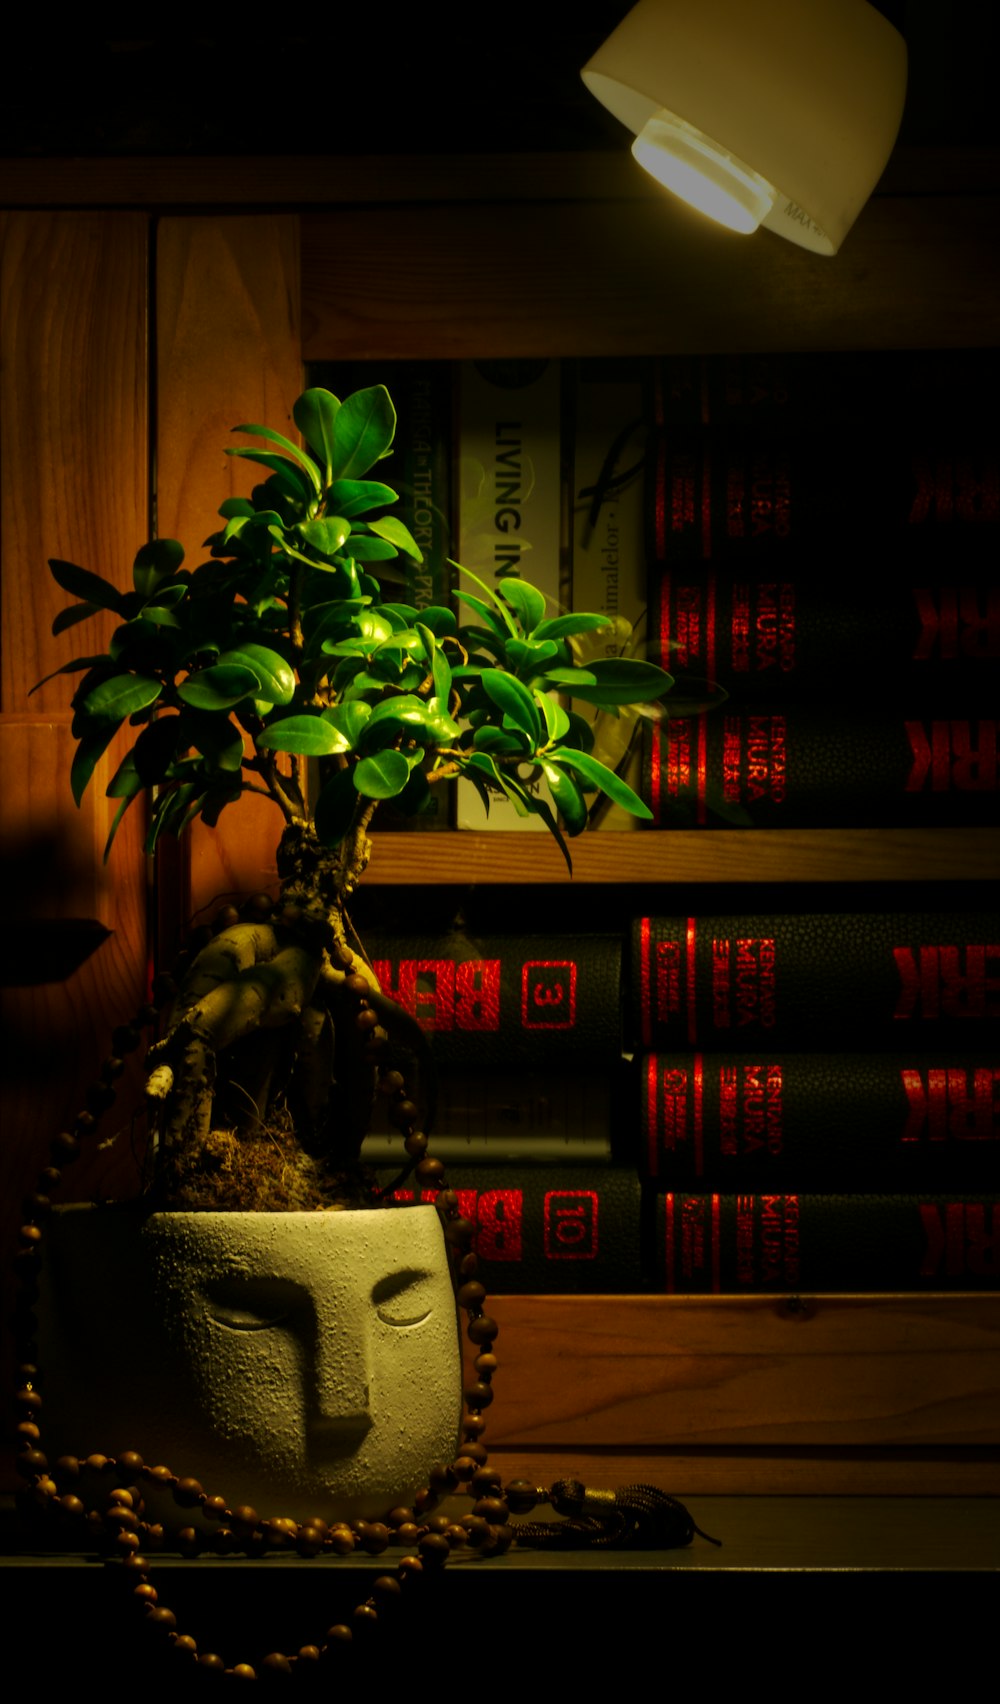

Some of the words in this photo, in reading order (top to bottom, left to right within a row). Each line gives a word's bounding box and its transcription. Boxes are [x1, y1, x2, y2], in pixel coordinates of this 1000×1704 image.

[784, 201, 813, 229] MAX
[413, 468, 432, 550] THEORY
[494, 421, 522, 533] LIVING
[494, 544, 521, 577] IN
[755, 583, 778, 672] MIURA
[747, 715, 769, 803] MIURA
[770, 715, 787, 804] KENTARO
[533, 983, 564, 1007] 3
[735, 938, 759, 1028] MIURA
[759, 938, 776, 1029] KENTARO
[742, 1065, 766, 1155] MIURA
[767, 1065, 783, 1156] KENTARO
[555, 1205, 587, 1244] 10
[760, 1195, 782, 1283] MIURA
[783, 1195, 800, 1285] KENTARO
